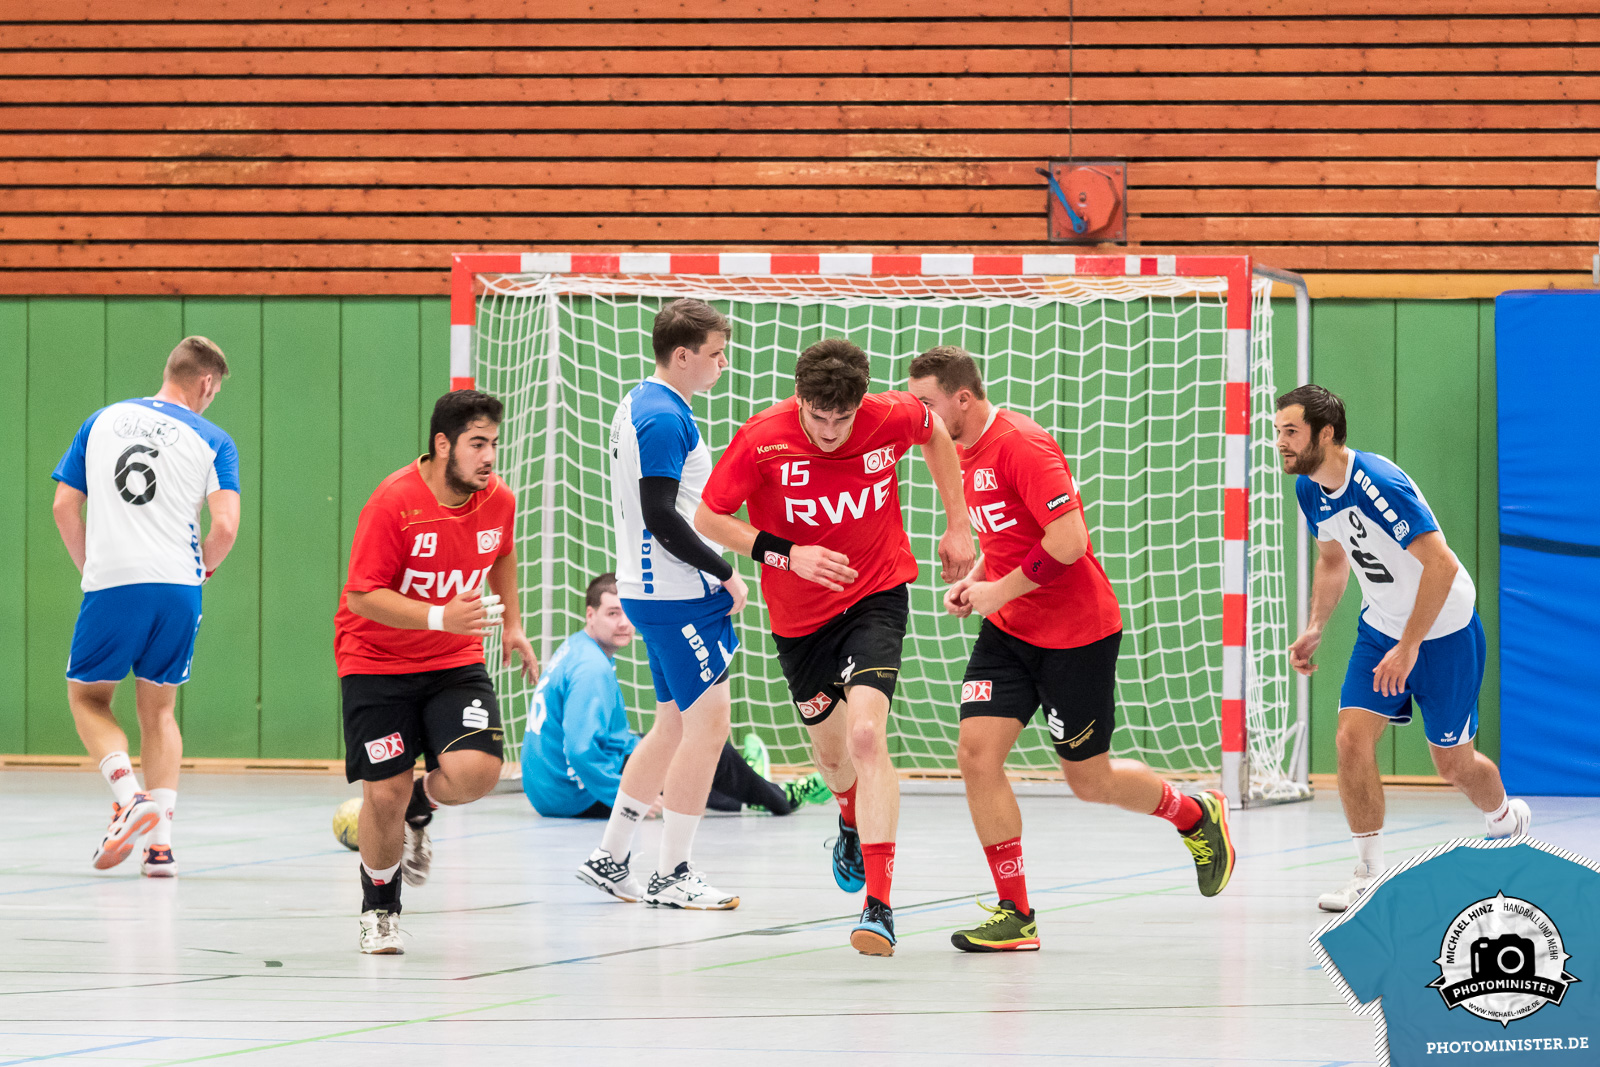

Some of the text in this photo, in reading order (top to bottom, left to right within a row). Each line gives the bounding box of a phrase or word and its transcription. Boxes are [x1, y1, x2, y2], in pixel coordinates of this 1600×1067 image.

[114, 444, 159, 505] 6
[780, 460, 811, 487] 15
[784, 475, 893, 527] RWE
[1047, 493, 1070, 511] Kempa
[410, 532, 438, 558] 19
